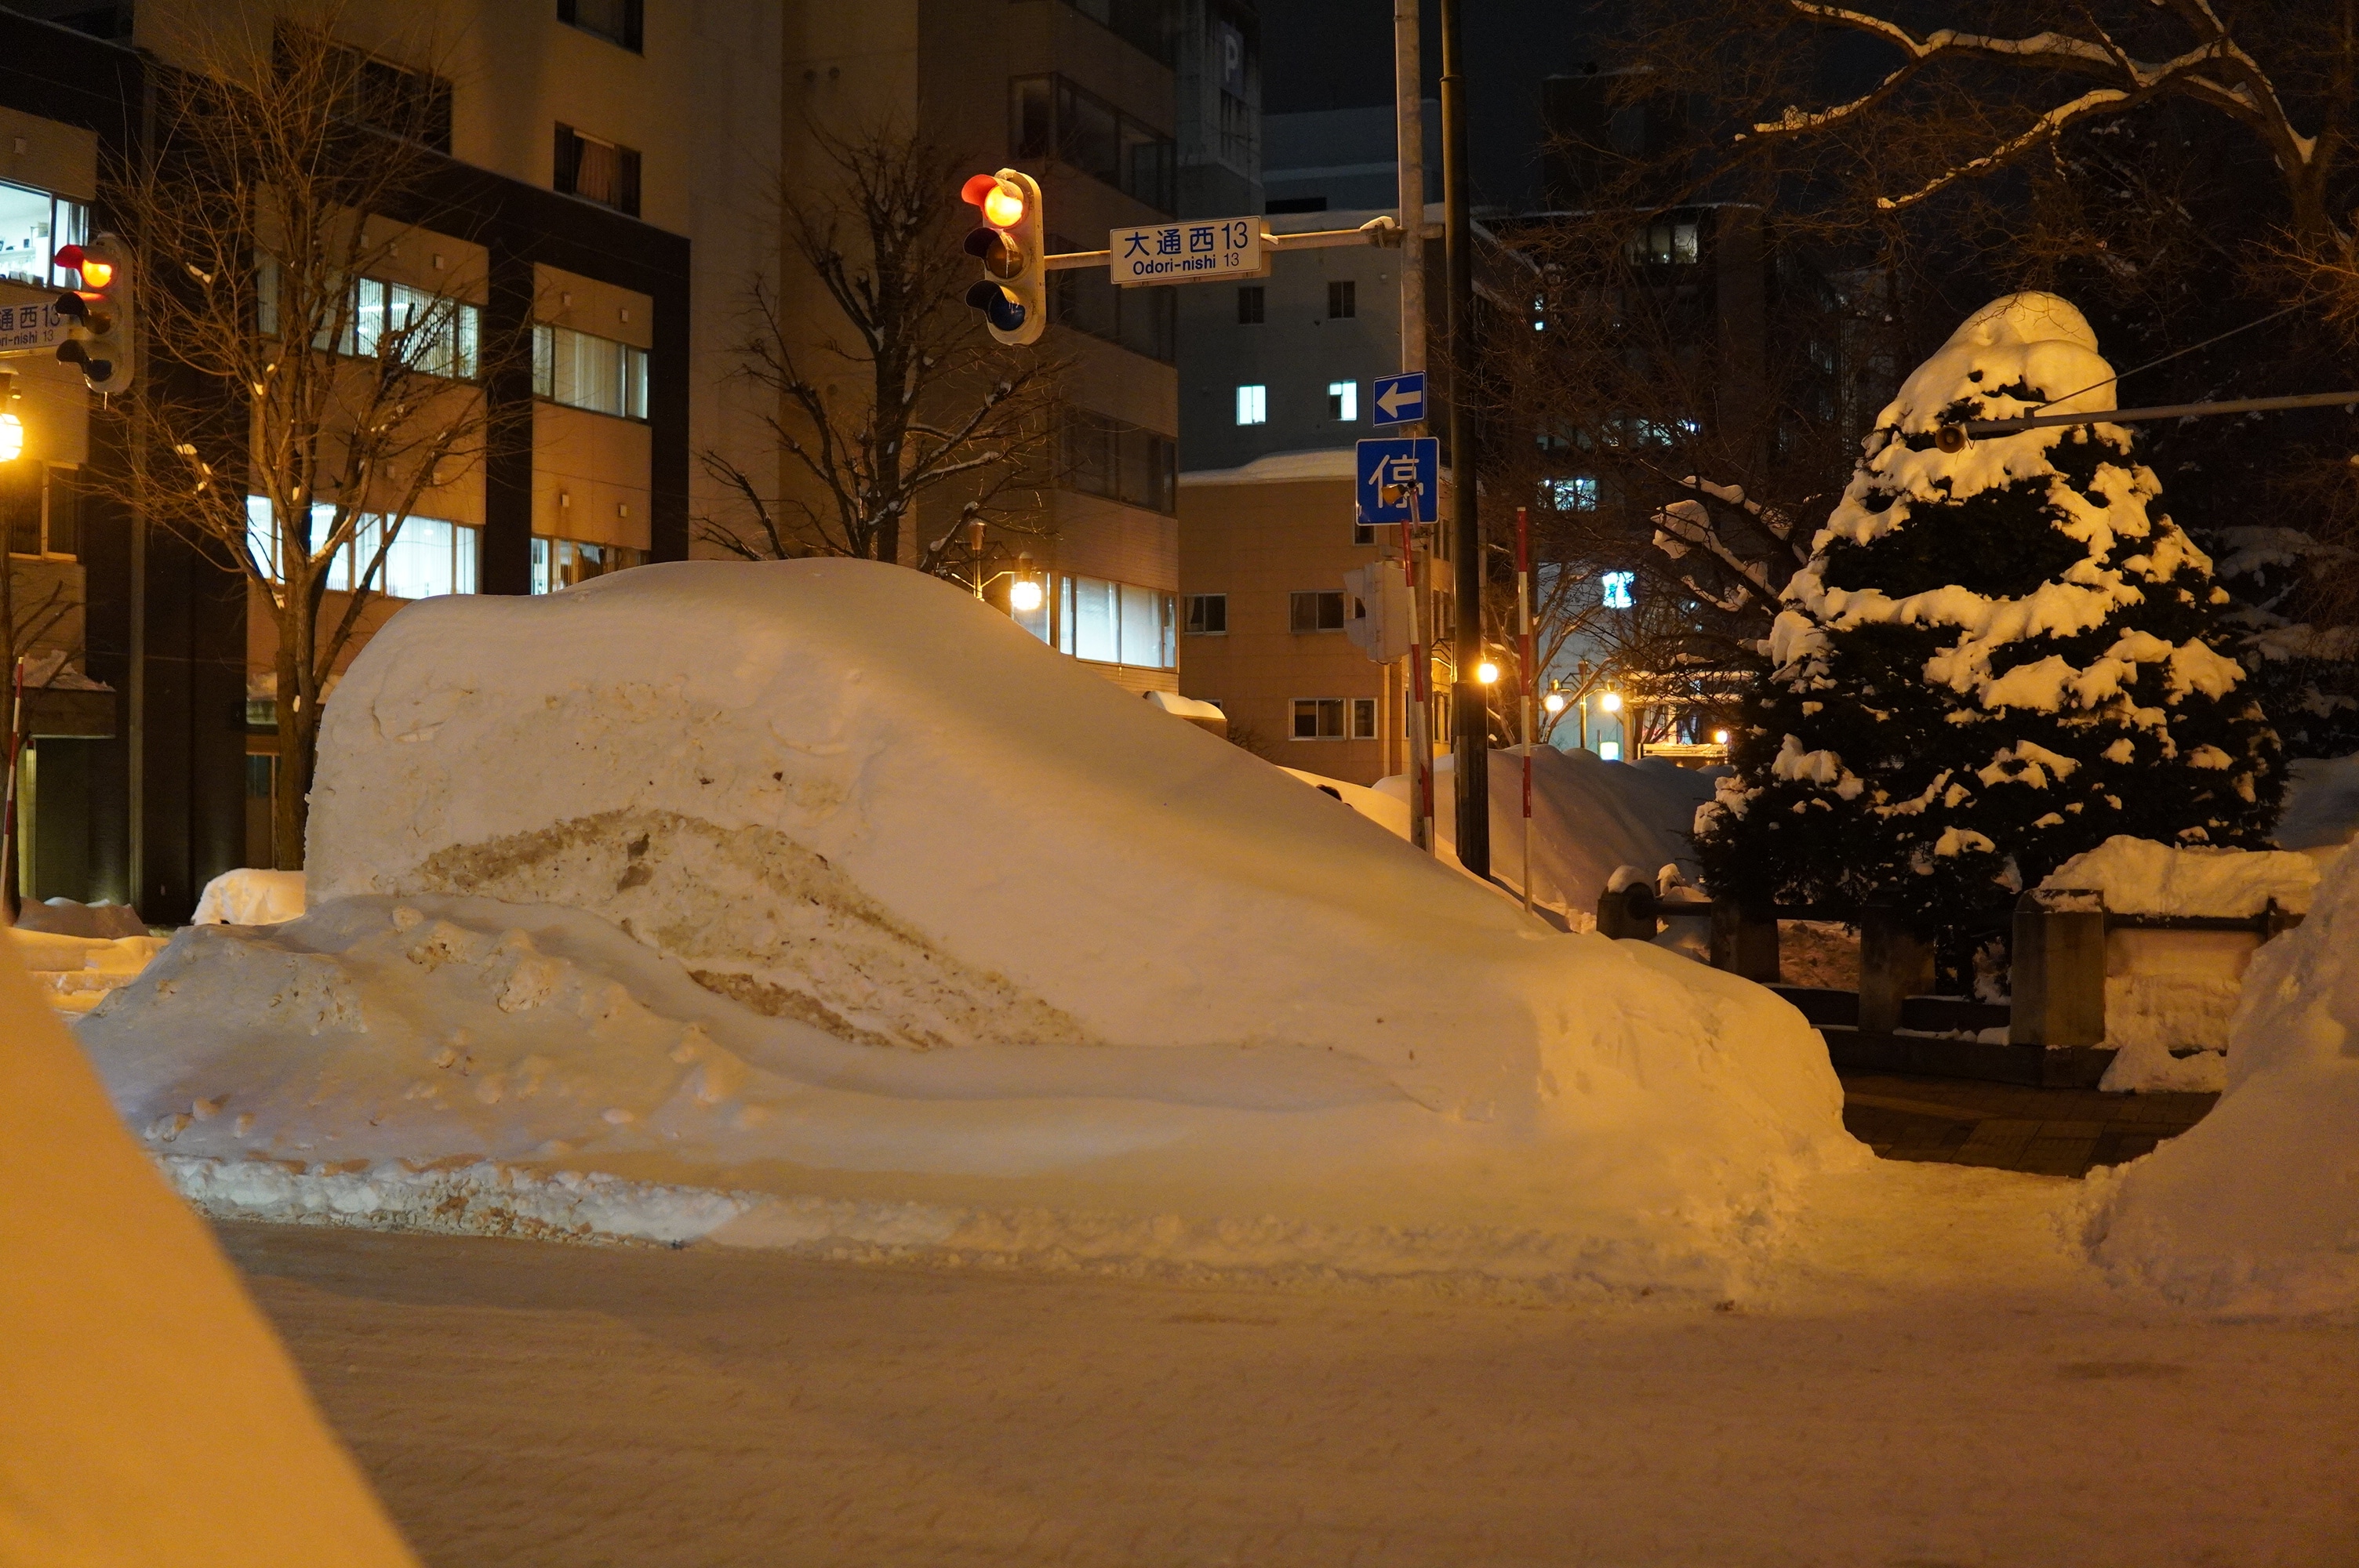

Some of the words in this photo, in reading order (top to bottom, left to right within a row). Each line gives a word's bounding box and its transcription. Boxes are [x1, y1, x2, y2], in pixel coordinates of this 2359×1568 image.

[1225, 34, 1238, 82] P
[1124, 221, 1249, 258] 大通西13
[1132, 255, 1216, 275] Odori-nishi
[1223, 252, 1240, 267] 13
[0, 330, 37, 346] ri-nishi
[43, 329, 53, 341] 13
[1369, 455, 1423, 508] 停
